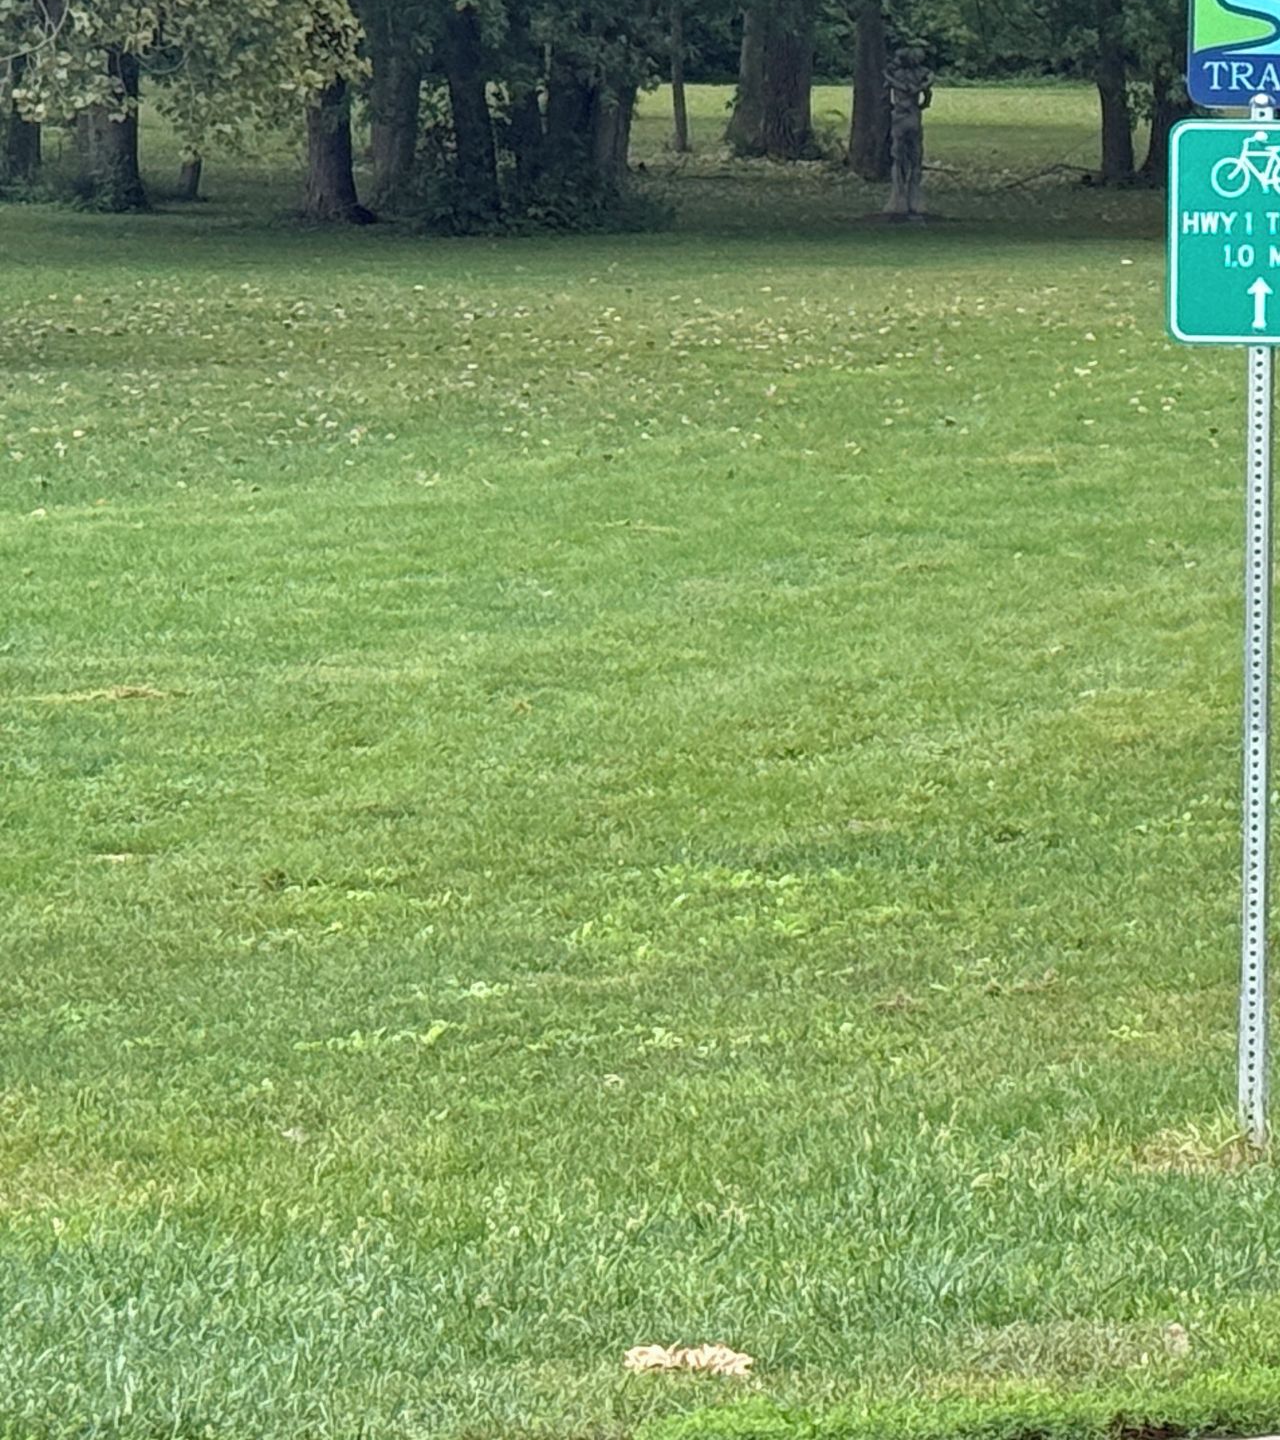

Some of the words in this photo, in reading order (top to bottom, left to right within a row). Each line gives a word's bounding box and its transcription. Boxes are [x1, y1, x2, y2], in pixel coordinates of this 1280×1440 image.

[1182, 211, 1237, 235] HWY
[1244, 211, 1253, 235] 1
[1223, 244, 1255, 268] 1.0
